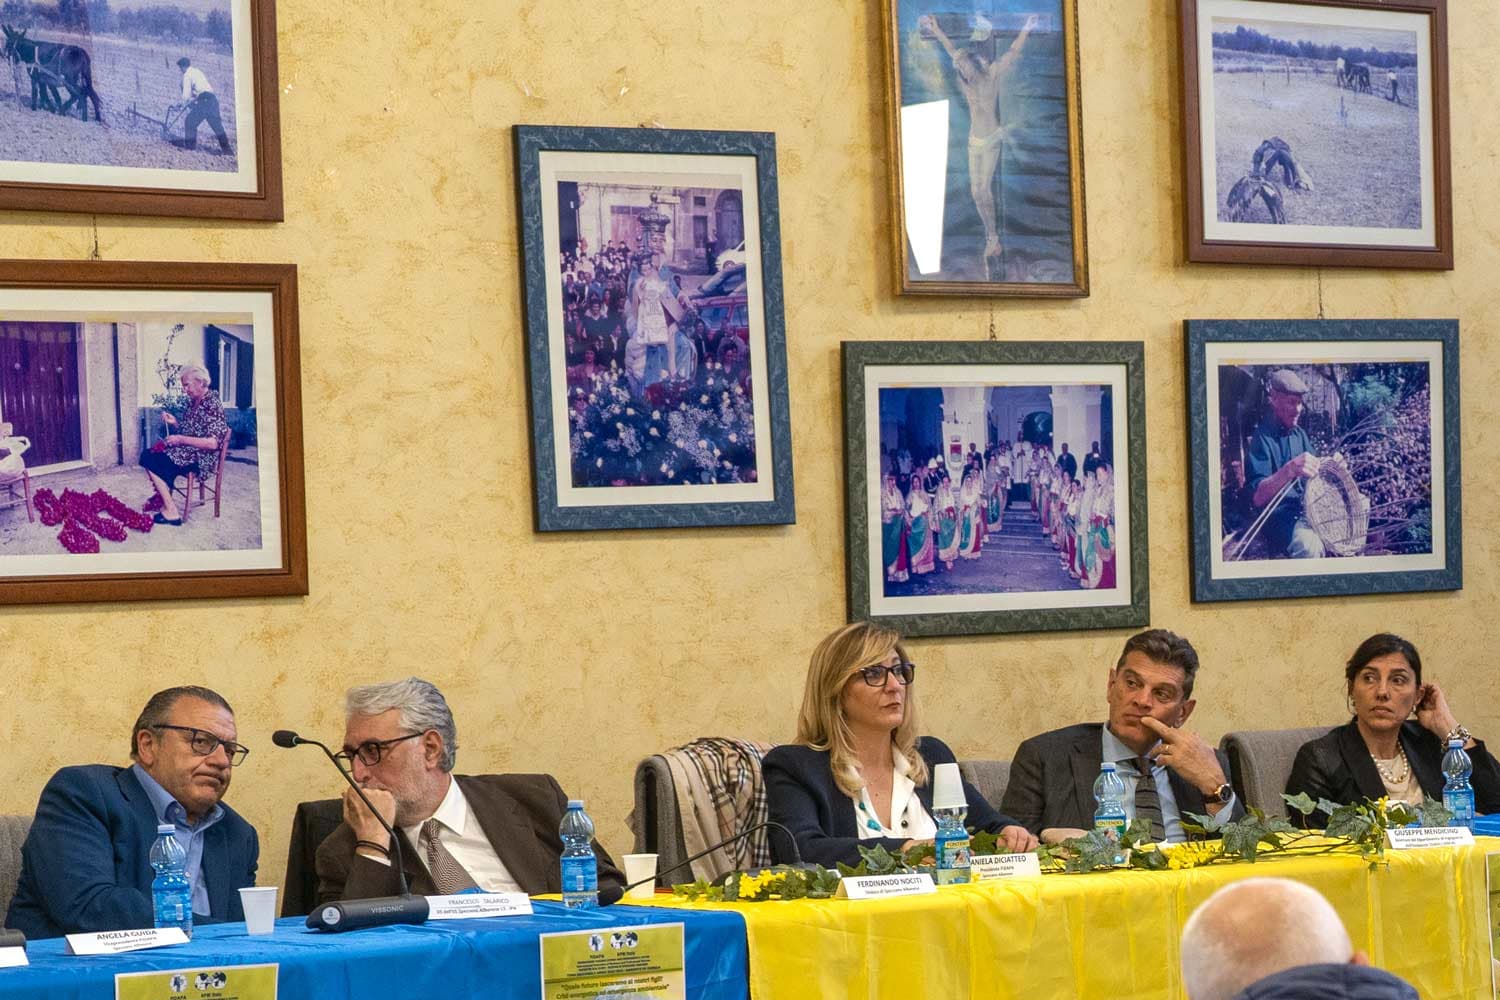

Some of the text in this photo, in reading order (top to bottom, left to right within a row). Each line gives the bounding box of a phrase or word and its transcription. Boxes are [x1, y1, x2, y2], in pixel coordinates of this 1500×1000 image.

[968, 855, 1026, 865] ANIELA DICIATTEO
[857, 878, 899, 888] FERDINANDO
[97, 932, 130, 940] ANGELA
